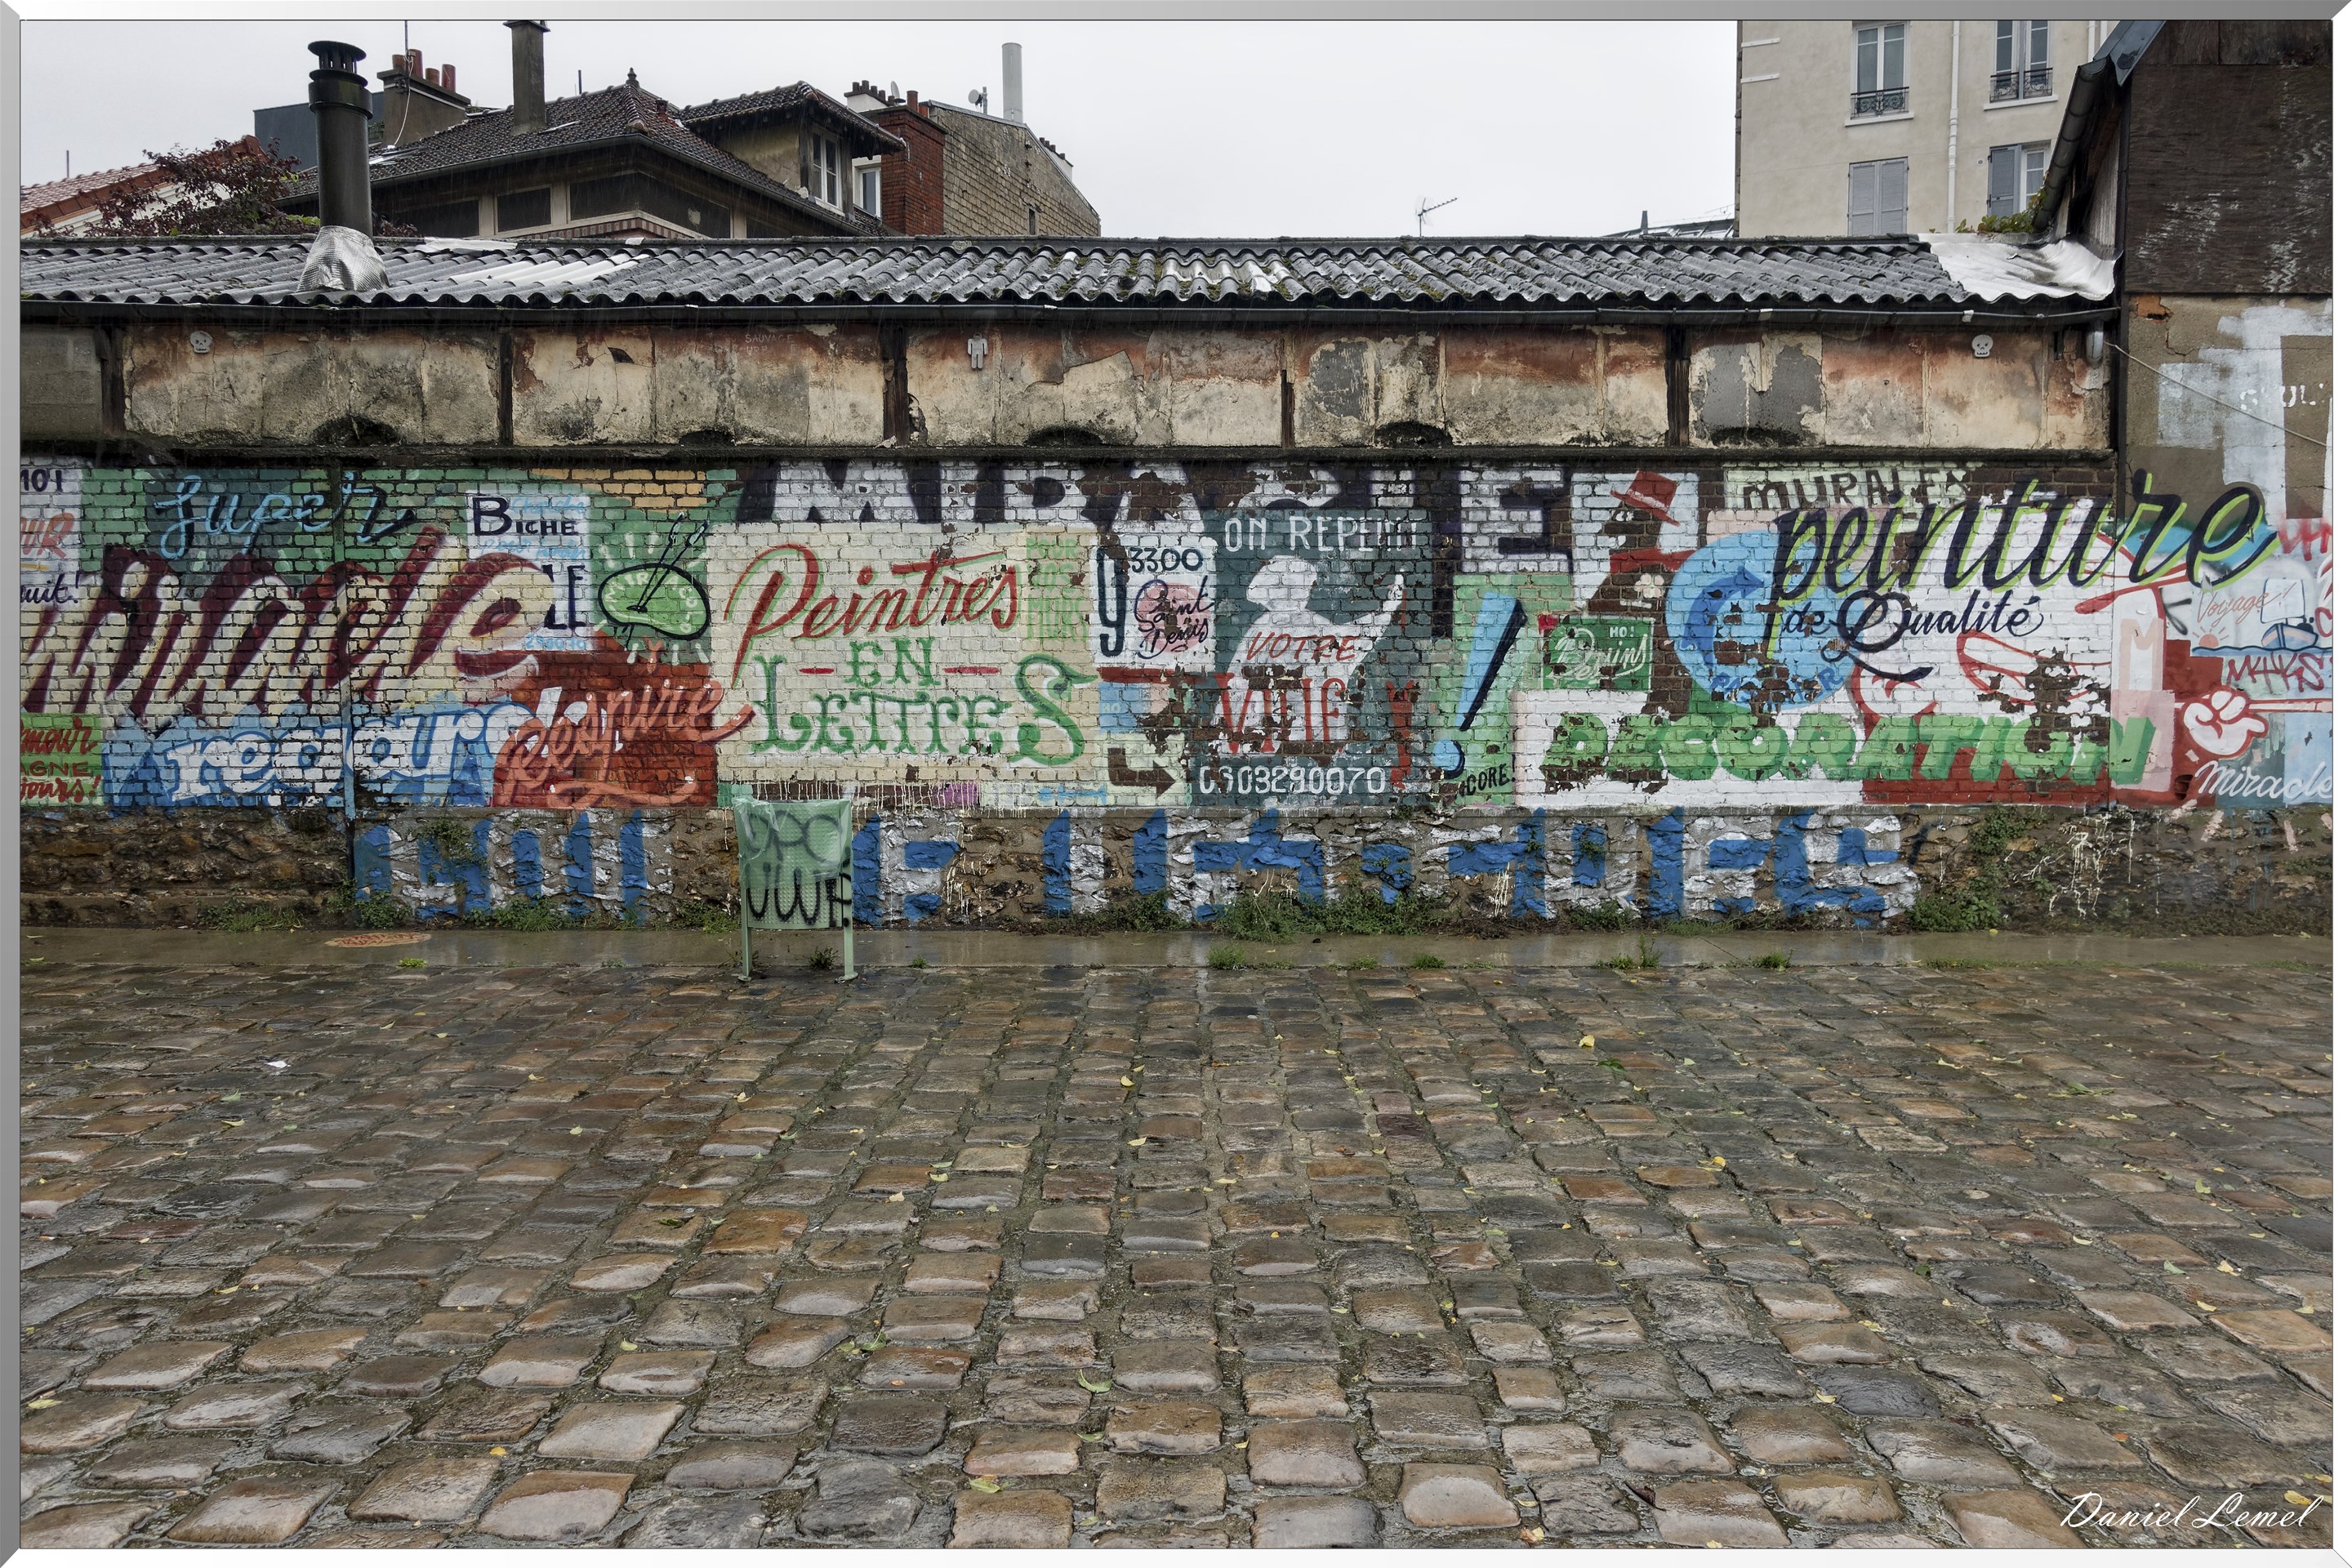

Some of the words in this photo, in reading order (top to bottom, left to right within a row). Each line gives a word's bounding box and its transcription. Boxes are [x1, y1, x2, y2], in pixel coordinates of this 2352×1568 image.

[1225, 518, 1266, 552] ON
[724, 542, 1021, 690] Peintres
[1781, 601, 1831, 635] de
[844, 637, 942, 688] EN
[1245, 630, 1361, 662] VOTRE
[749, 653, 1098, 766] LETTRES
